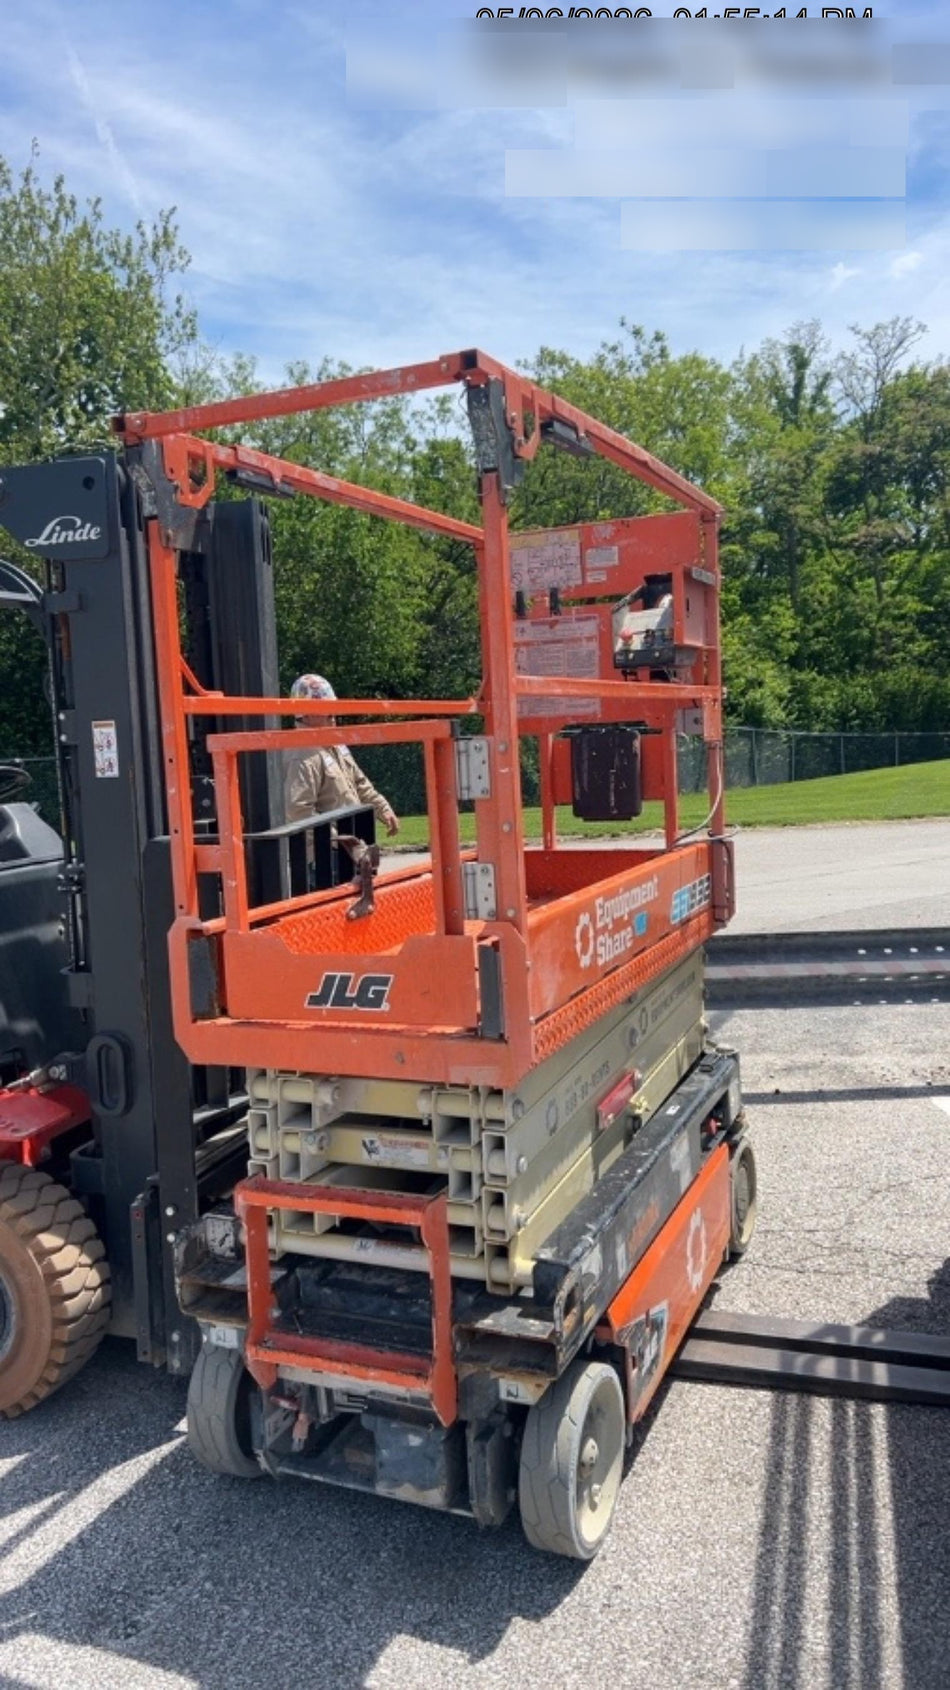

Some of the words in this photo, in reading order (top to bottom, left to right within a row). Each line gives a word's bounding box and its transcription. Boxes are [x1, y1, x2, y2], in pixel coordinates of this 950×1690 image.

[24, 515, 101, 547] Linde
[594, 874, 658, 930] Equipment
[596, 925, 634, 967] Share
[304, 972, 394, 1011] JLG
